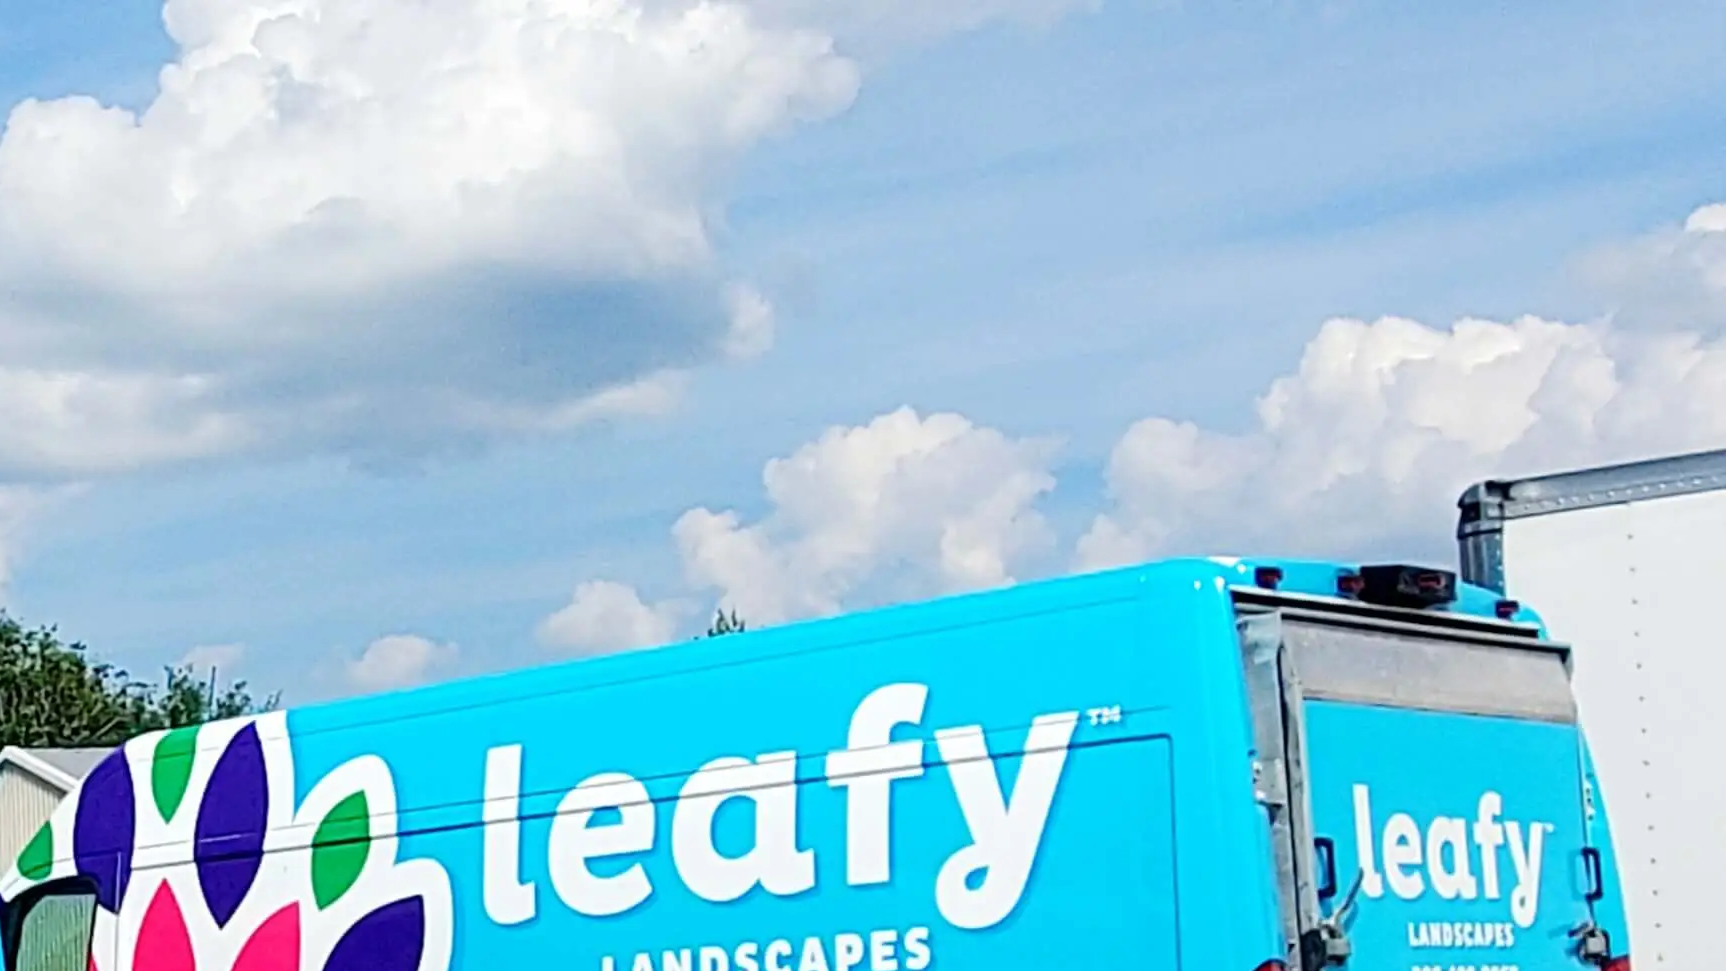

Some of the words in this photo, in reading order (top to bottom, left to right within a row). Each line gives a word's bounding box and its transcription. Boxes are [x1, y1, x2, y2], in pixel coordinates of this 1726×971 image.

[482, 682, 1079, 930] leafy
[1352, 783, 1546, 928] leafy
[1407, 921, 1515, 948] LANDSCAPES
